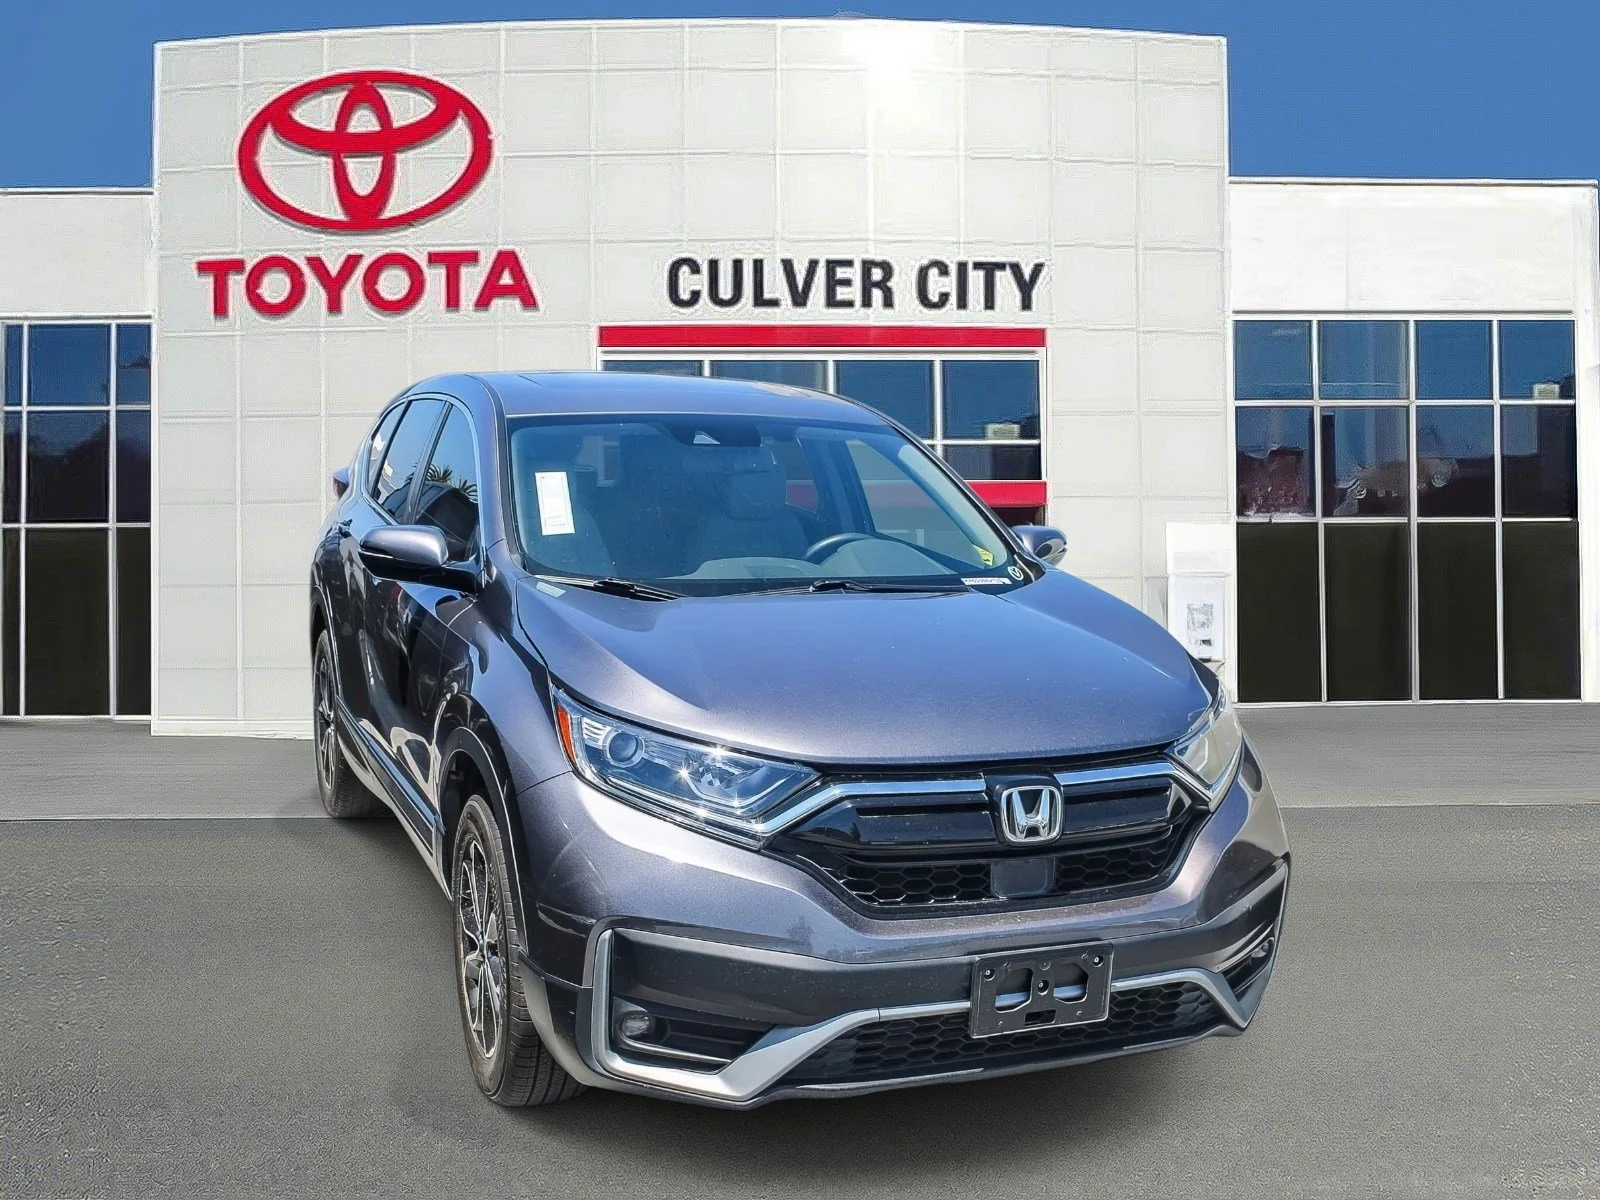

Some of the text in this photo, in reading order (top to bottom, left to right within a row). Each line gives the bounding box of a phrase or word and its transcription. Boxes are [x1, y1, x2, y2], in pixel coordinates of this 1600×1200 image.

[197, 251, 538, 317] TOYOTA
[668, 257, 1045, 311] CULVER CITY
